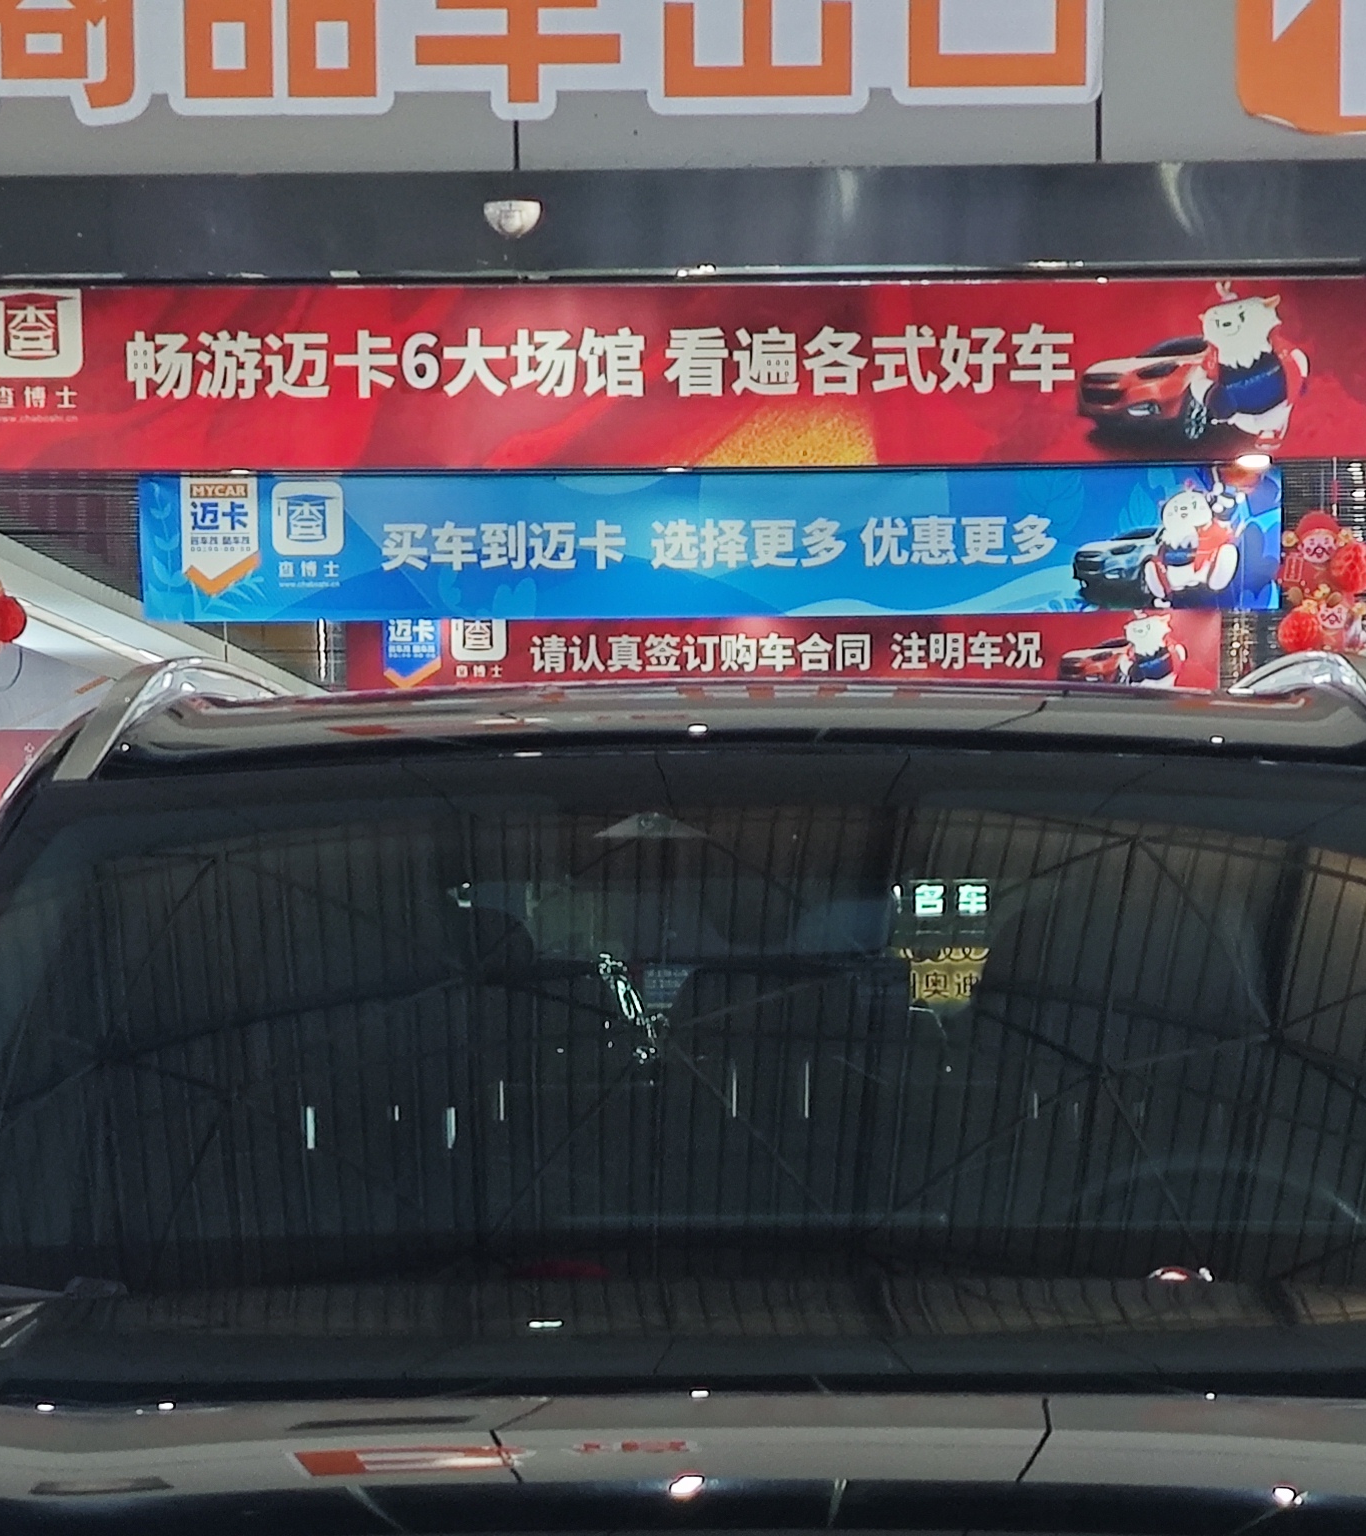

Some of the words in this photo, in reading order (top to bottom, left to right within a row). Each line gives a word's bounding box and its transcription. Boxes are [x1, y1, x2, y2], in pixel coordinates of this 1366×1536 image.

[126, 327, 645, 402] 畅游迈卡6大场馆
[665, 325, 1076, 399] 看遍各式好车
[191, 484, 247, 498] MYCAR
[191, 501, 249, 531] 迈卡
[382, 521, 627, 572] 买车到迈卡
[650, 518, 847, 570] 选择更多
[861, 514, 1059, 568] 优惠更多
[278, 560, 340, 578] 查博士
[388, 618, 435, 643] 迈卡
[529, 631, 872, 675] 请认真签订购车合同
[890, 630, 1043, 670] 注明车况
[914, 884, 987, 914] 名车
